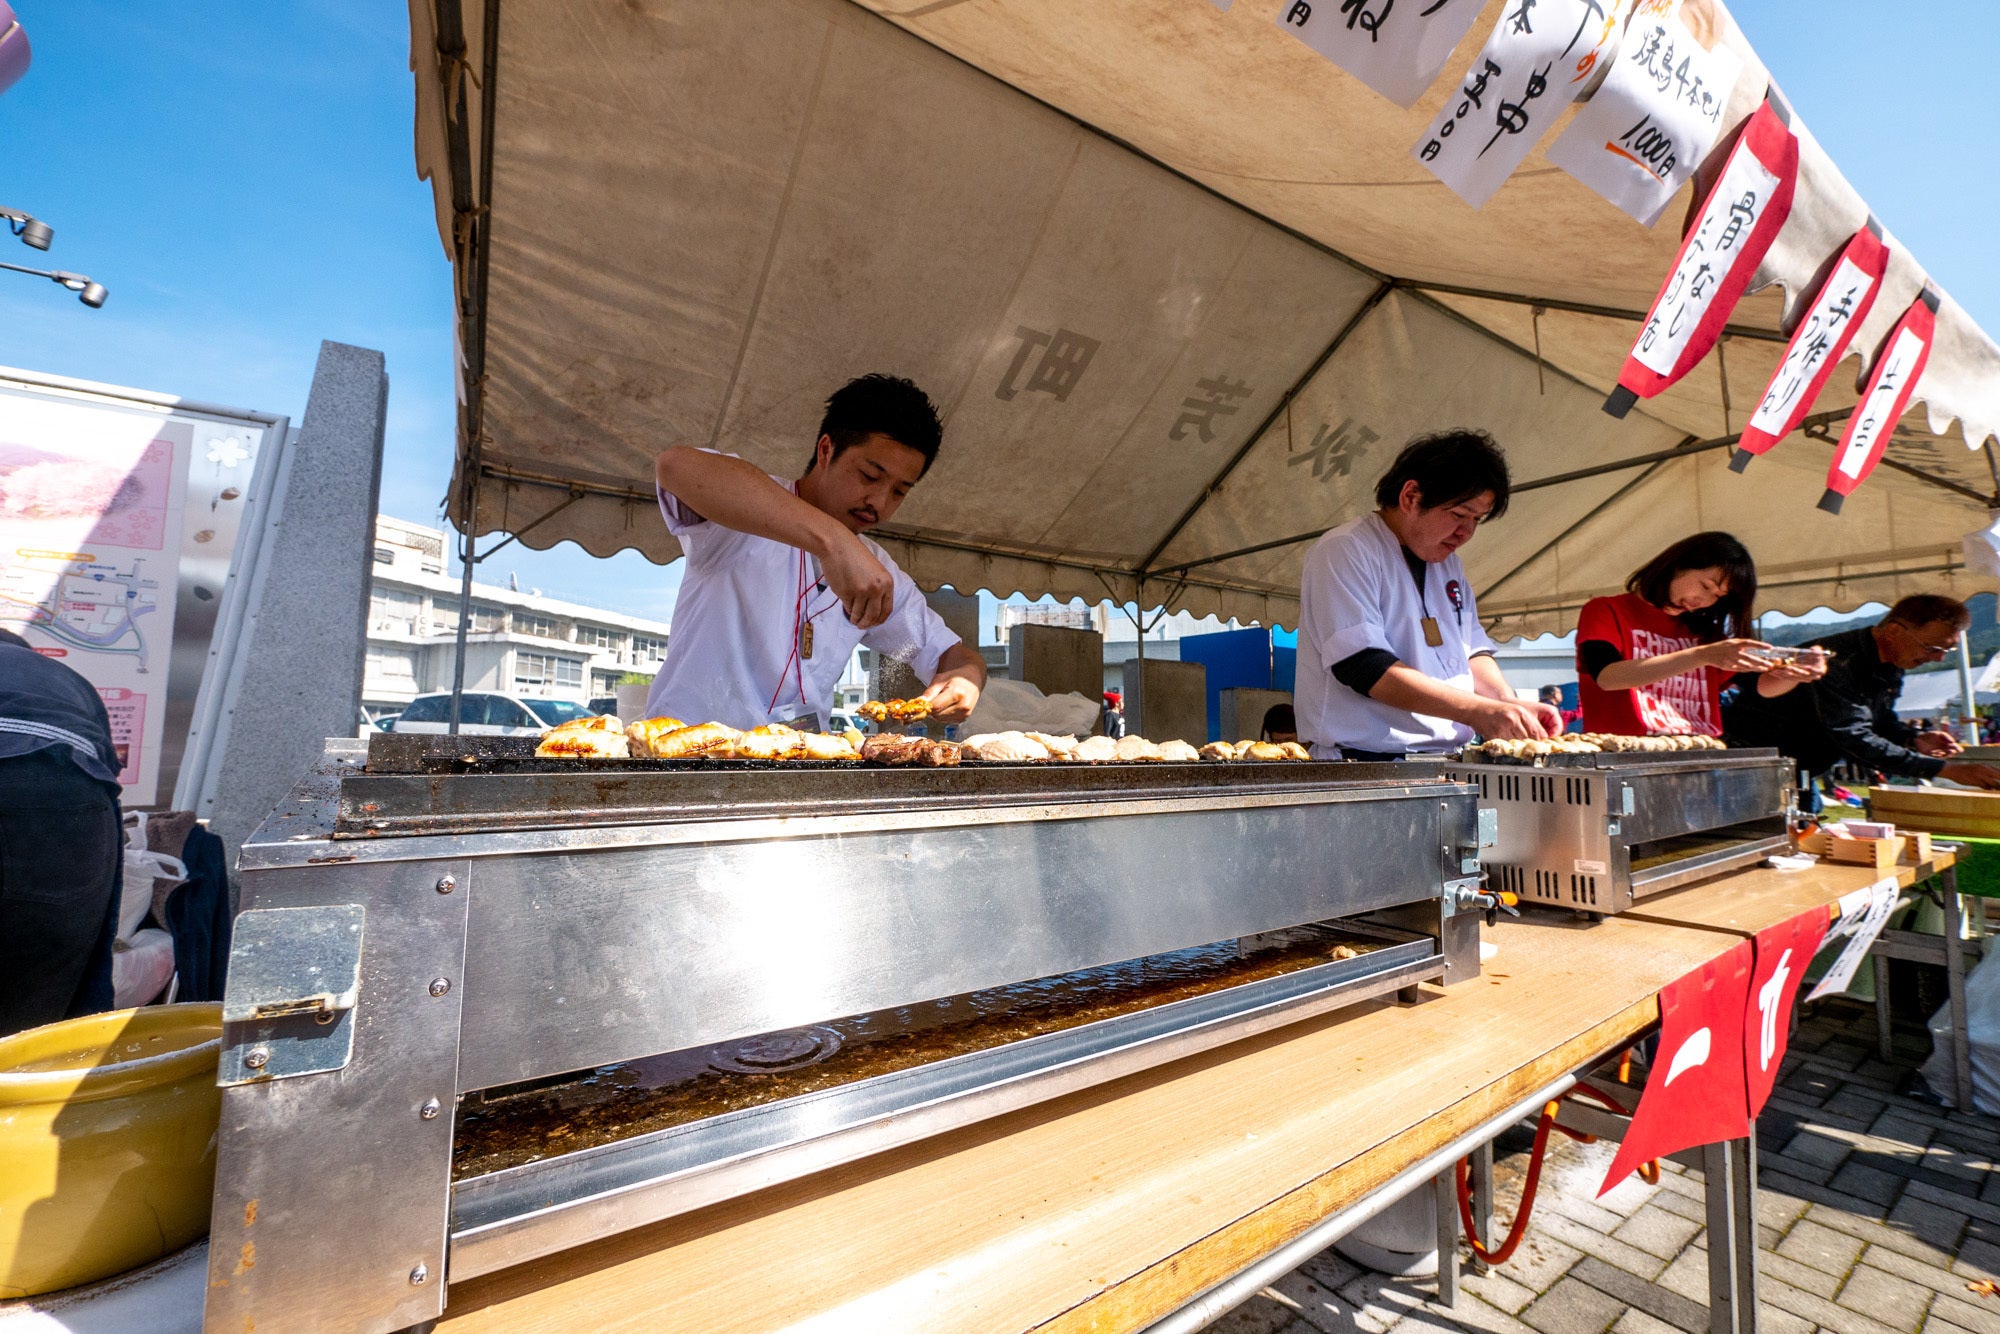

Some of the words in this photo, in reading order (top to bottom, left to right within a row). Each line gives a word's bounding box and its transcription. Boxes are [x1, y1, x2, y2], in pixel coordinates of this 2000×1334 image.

[1667, 190, 1756, 339] 骨なし
[1774, 286, 1858, 413] 手作り
